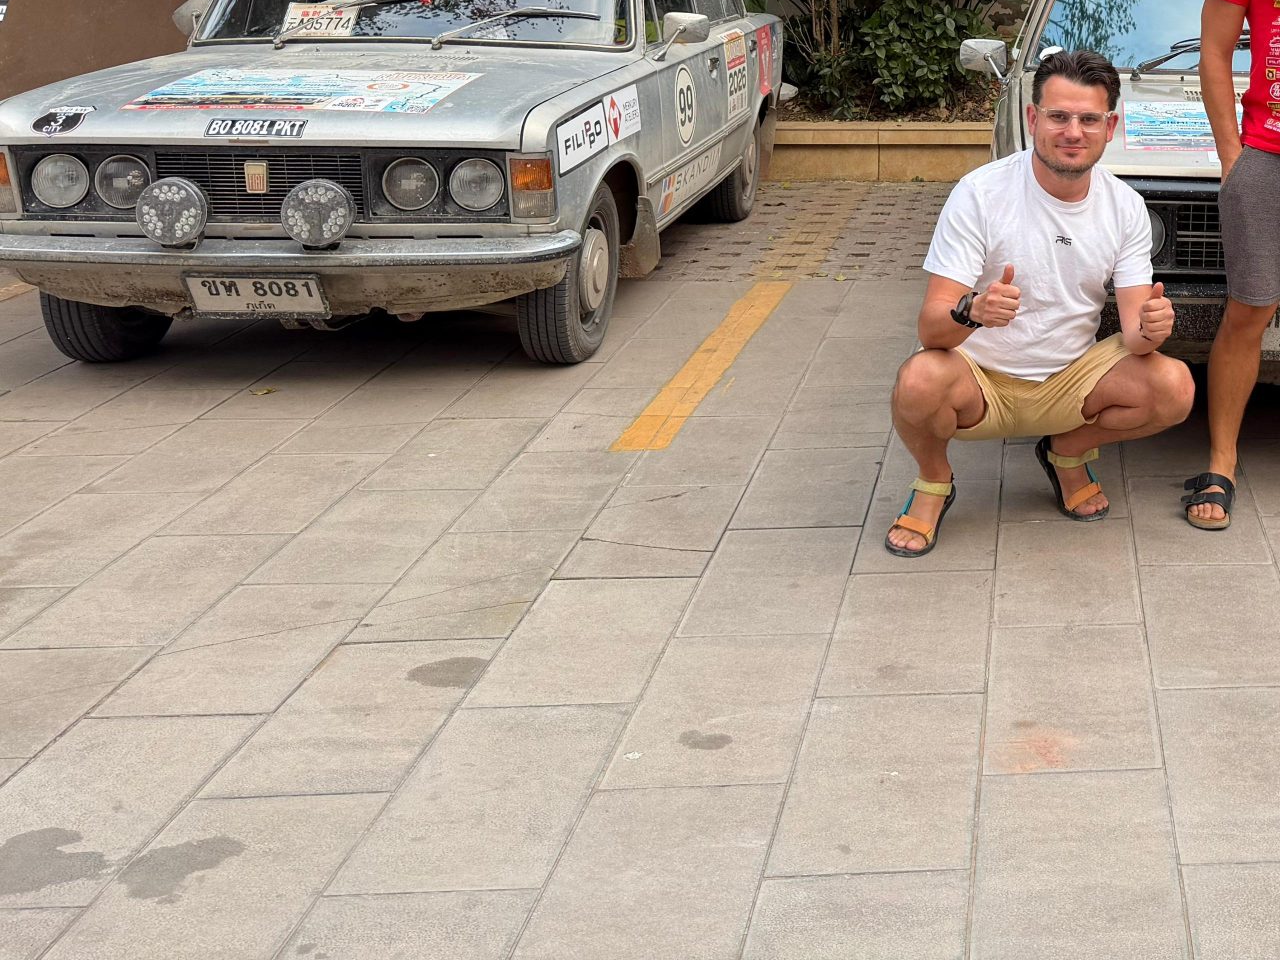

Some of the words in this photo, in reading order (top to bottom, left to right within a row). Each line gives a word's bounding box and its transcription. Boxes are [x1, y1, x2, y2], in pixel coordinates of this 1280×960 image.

[729, 65, 747, 97] 2026
[679, 84, 694, 128] 99
[50, 115, 67, 126] 3
[208, 120, 232, 135] BO
[232, 120, 271, 135] 8081
[271, 120, 304, 136] PKT
[564, 119, 602, 156] FILIPPO
[251, 280, 314, 298] 8081
